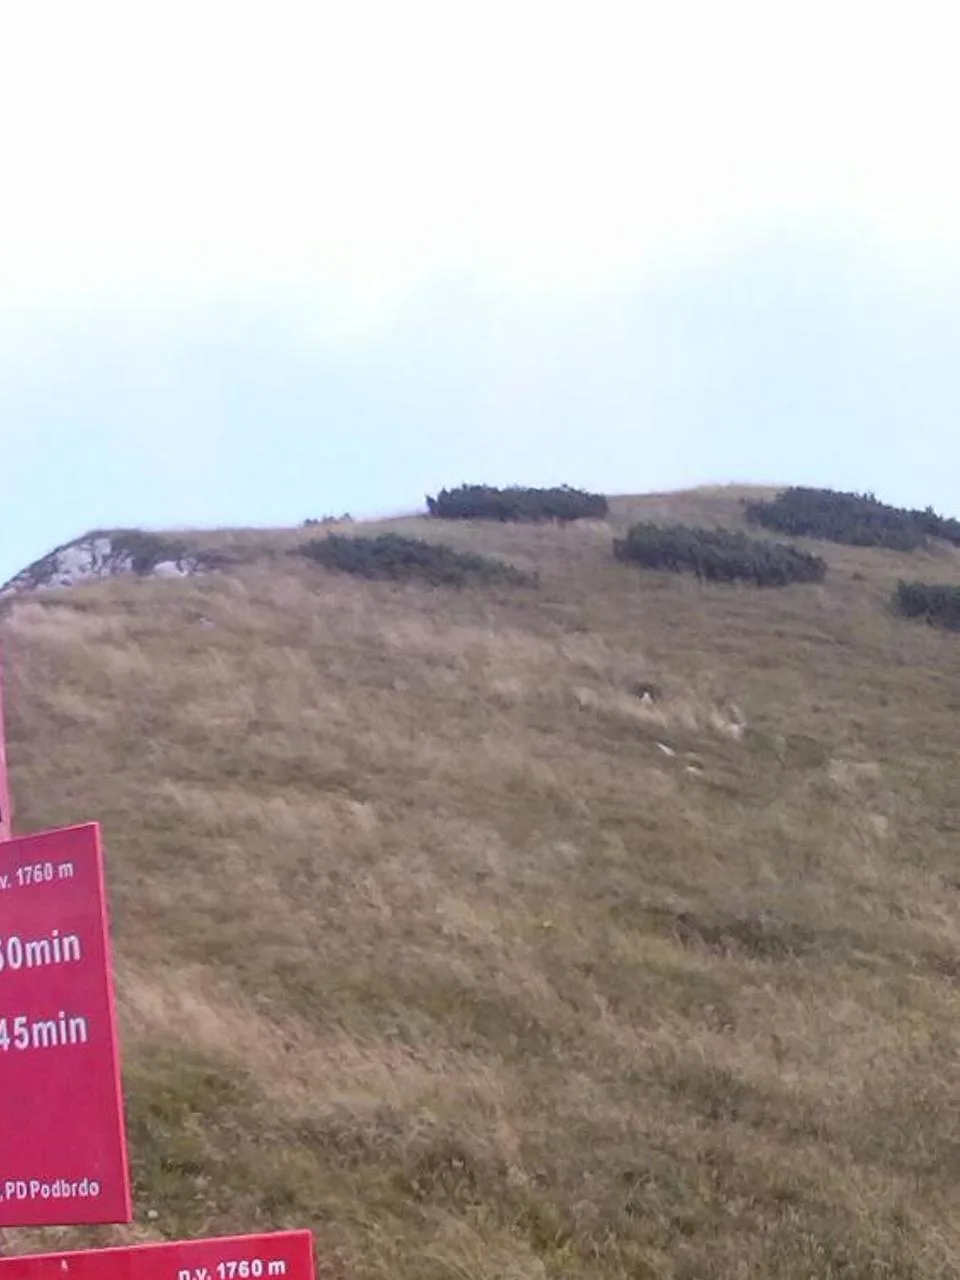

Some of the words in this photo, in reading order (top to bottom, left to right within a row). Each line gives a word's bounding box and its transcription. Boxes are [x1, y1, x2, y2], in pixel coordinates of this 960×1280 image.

[15, 862, 54, 886] 1760
[57, 862, 74, 879] m
[4, 1180, 28, 1200] PD
[29, 1177, 100, 1199] Podbrdo
[216, 1258, 263, 1280] 1760
[267, 1260, 286, 1276] m
